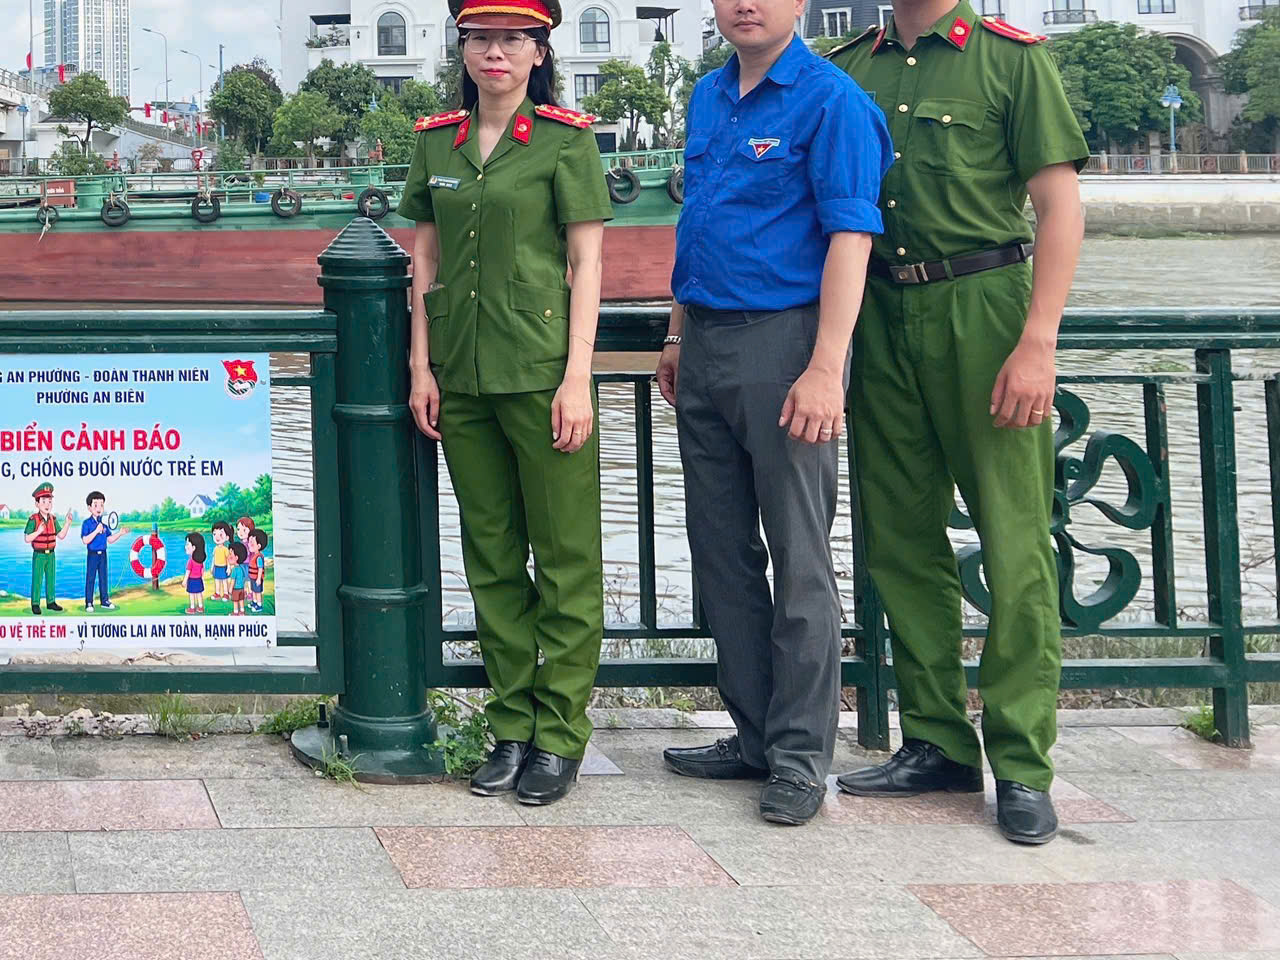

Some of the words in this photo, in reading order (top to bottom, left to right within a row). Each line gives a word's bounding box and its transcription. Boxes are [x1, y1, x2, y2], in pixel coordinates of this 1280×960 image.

[6, 371, 24, 383] AN
[28, 368, 80, 383] PHƯỜNG
[93, 368, 128, 382] ĐOÀN
[132, 370, 174, 382] THANH
[178, 367, 209, 381] NIÊN
[36, 388, 89, 404] PHƯỜNG
[93, 391, 111, 403] AN
[114, 388, 145, 403] BIÊN
[0, 421, 53, 451] BIỂN
[60, 422, 125, 451] CẢNH
[133, 423, 181, 450] BÁO
[20, 455, 74, 478] CHỐNG
[78, 455, 115, 477] ĐUỐI
[120, 456, 163, 477] NƯỚC
[167, 455, 197, 476] TRẺ
[201, 460, 223, 476] EM
[9, 622, 23, 641] VỆ
[26, 620, 46, 638] TRẺ
[49, 625, 66, 638] EM
[77, 621, 87, 638] VÌ
[91, 623, 127, 637] TƯƠNG
[130, 624, 147, 637] LAI
[150, 624, 166, 637] AN
[169, 621, 202, 639] TOÀN,
[205, 624, 235, 640] HẠNH
[238, 621, 268, 637] PHÚC
